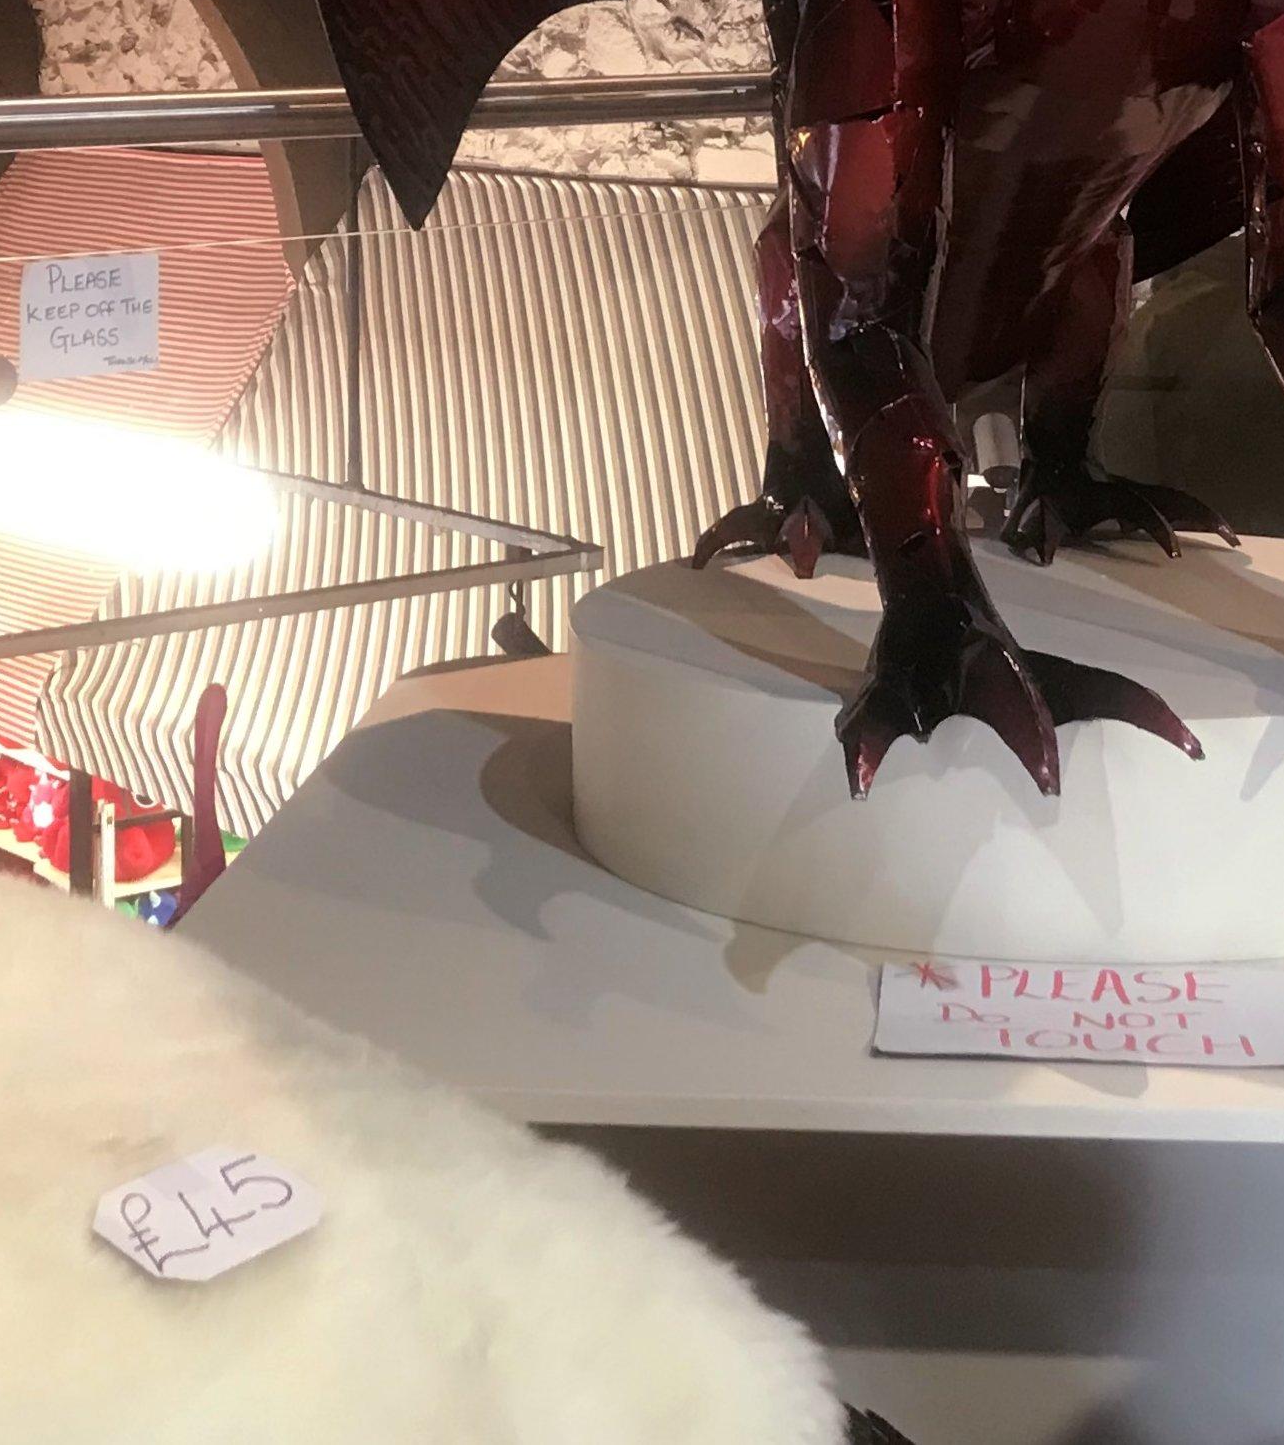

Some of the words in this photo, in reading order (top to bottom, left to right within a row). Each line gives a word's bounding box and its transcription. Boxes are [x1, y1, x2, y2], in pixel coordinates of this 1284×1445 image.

[47, 264, 121, 293] PLEASE
[27, 303, 80, 324] KEEP
[120, 297, 153, 315] THE
[50, 327, 119, 353] GLASS
[980, 964, 1229, 1005] PLEASE
[1072, 1011, 1201, 1030] NOT
[987, 1028, 1257, 1057] TOUCH
[120, 1154, 292, 1275] £45
